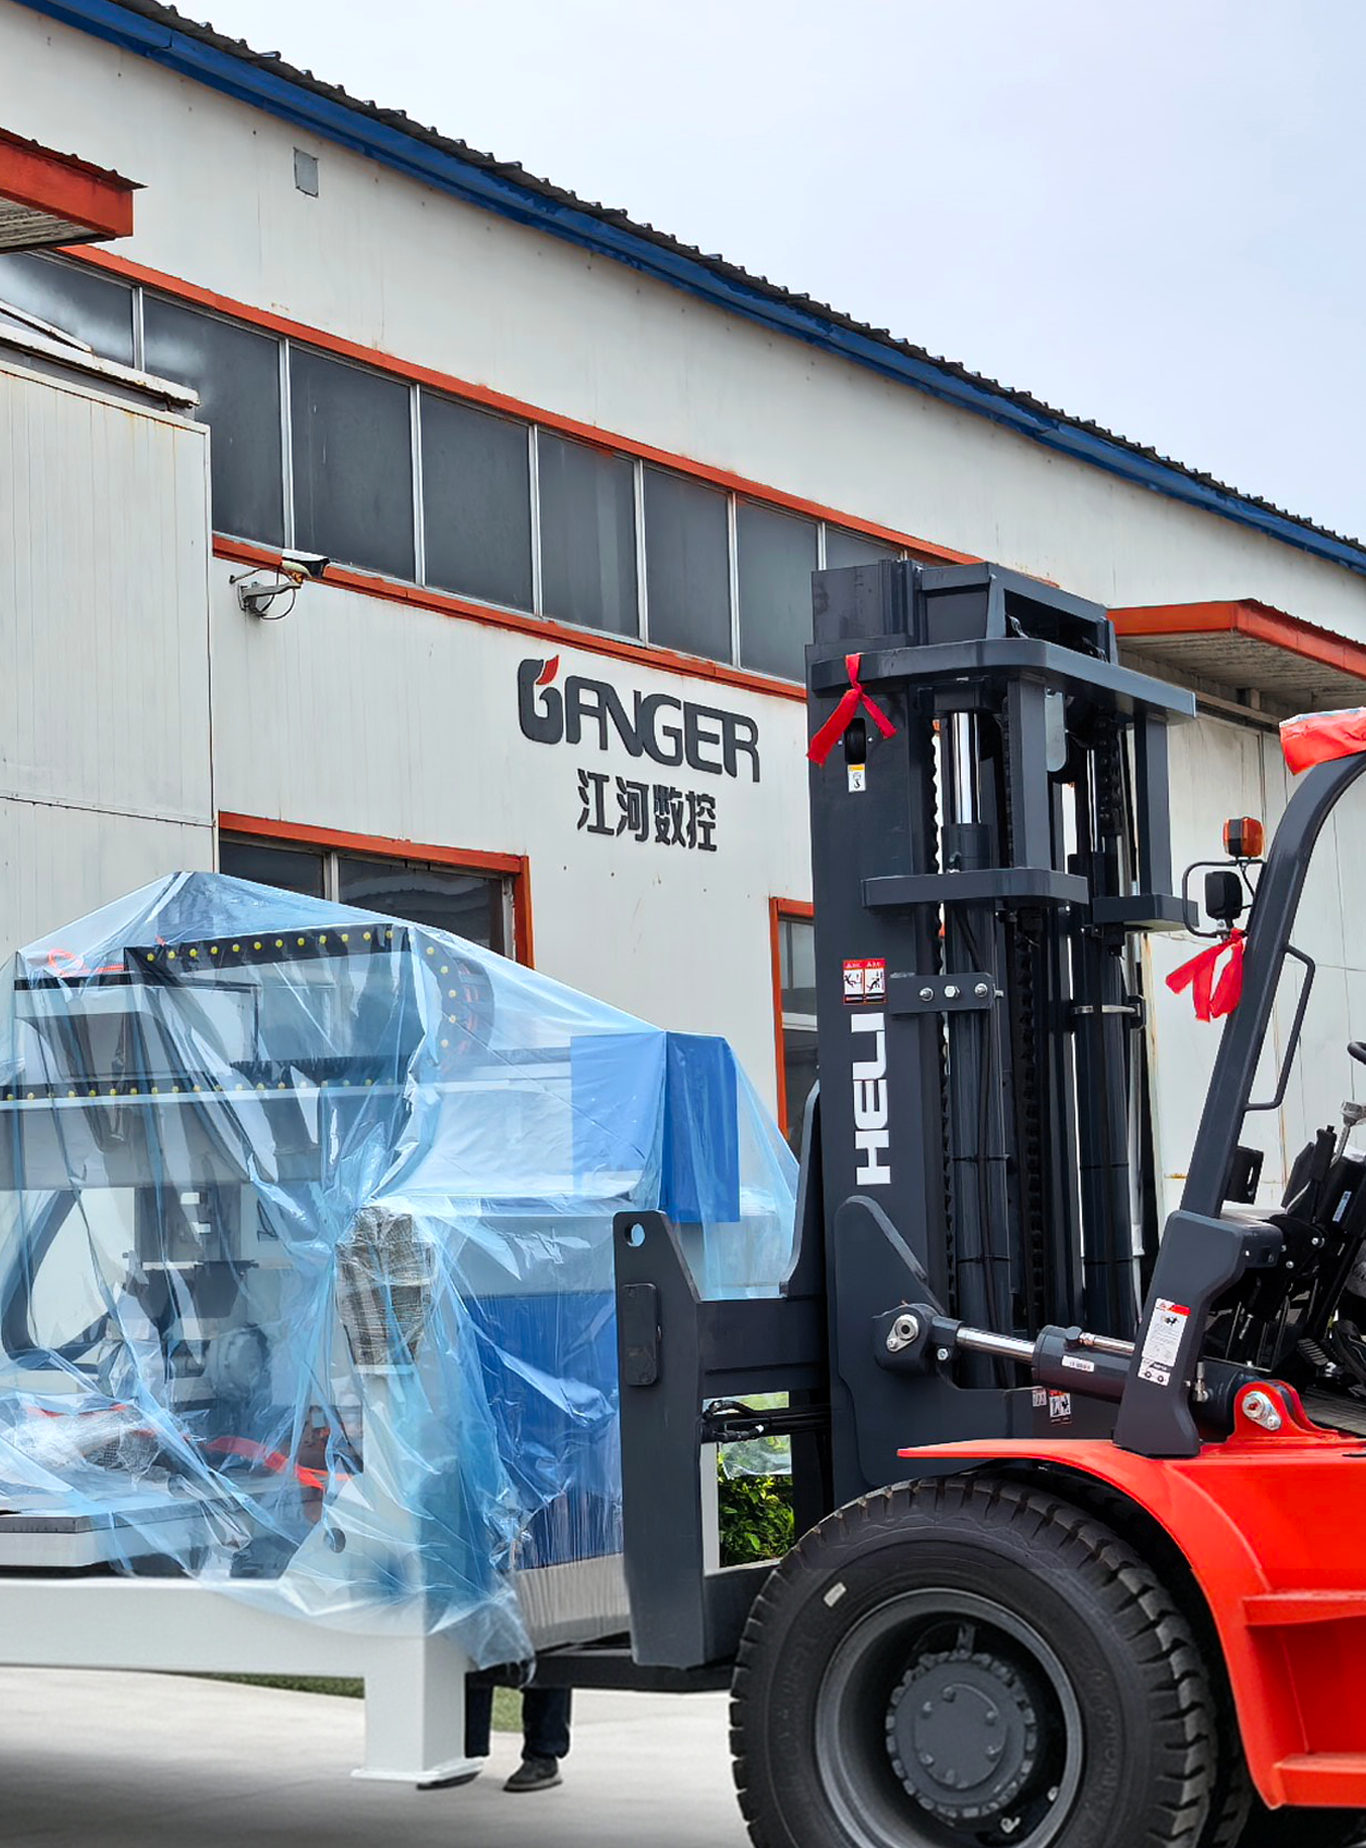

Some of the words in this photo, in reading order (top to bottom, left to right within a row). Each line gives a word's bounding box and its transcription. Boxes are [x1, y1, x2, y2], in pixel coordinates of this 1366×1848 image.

[576, 767, 718, 852] 江河数控
[850, 1012, 892, 1186] HELI
